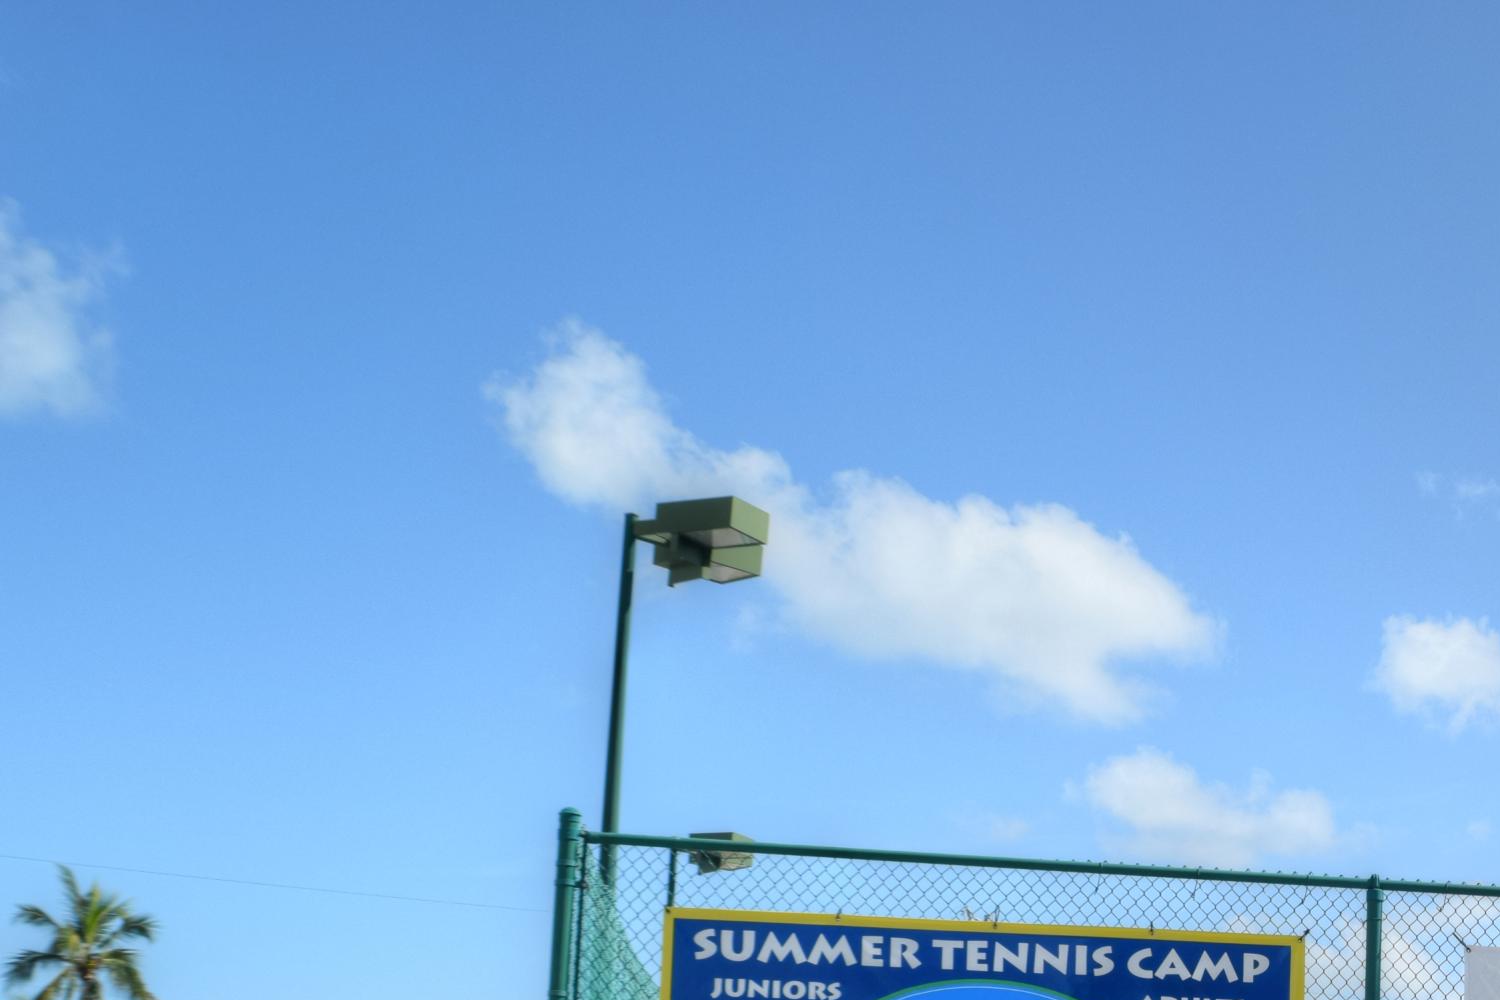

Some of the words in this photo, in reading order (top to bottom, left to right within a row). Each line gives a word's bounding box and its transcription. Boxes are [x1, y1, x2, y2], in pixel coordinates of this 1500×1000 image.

[693, 928, 922, 971] SUMMER
[932, 939, 1115, 978] TENNIS
[1127, 947, 1271, 984] CAMP
